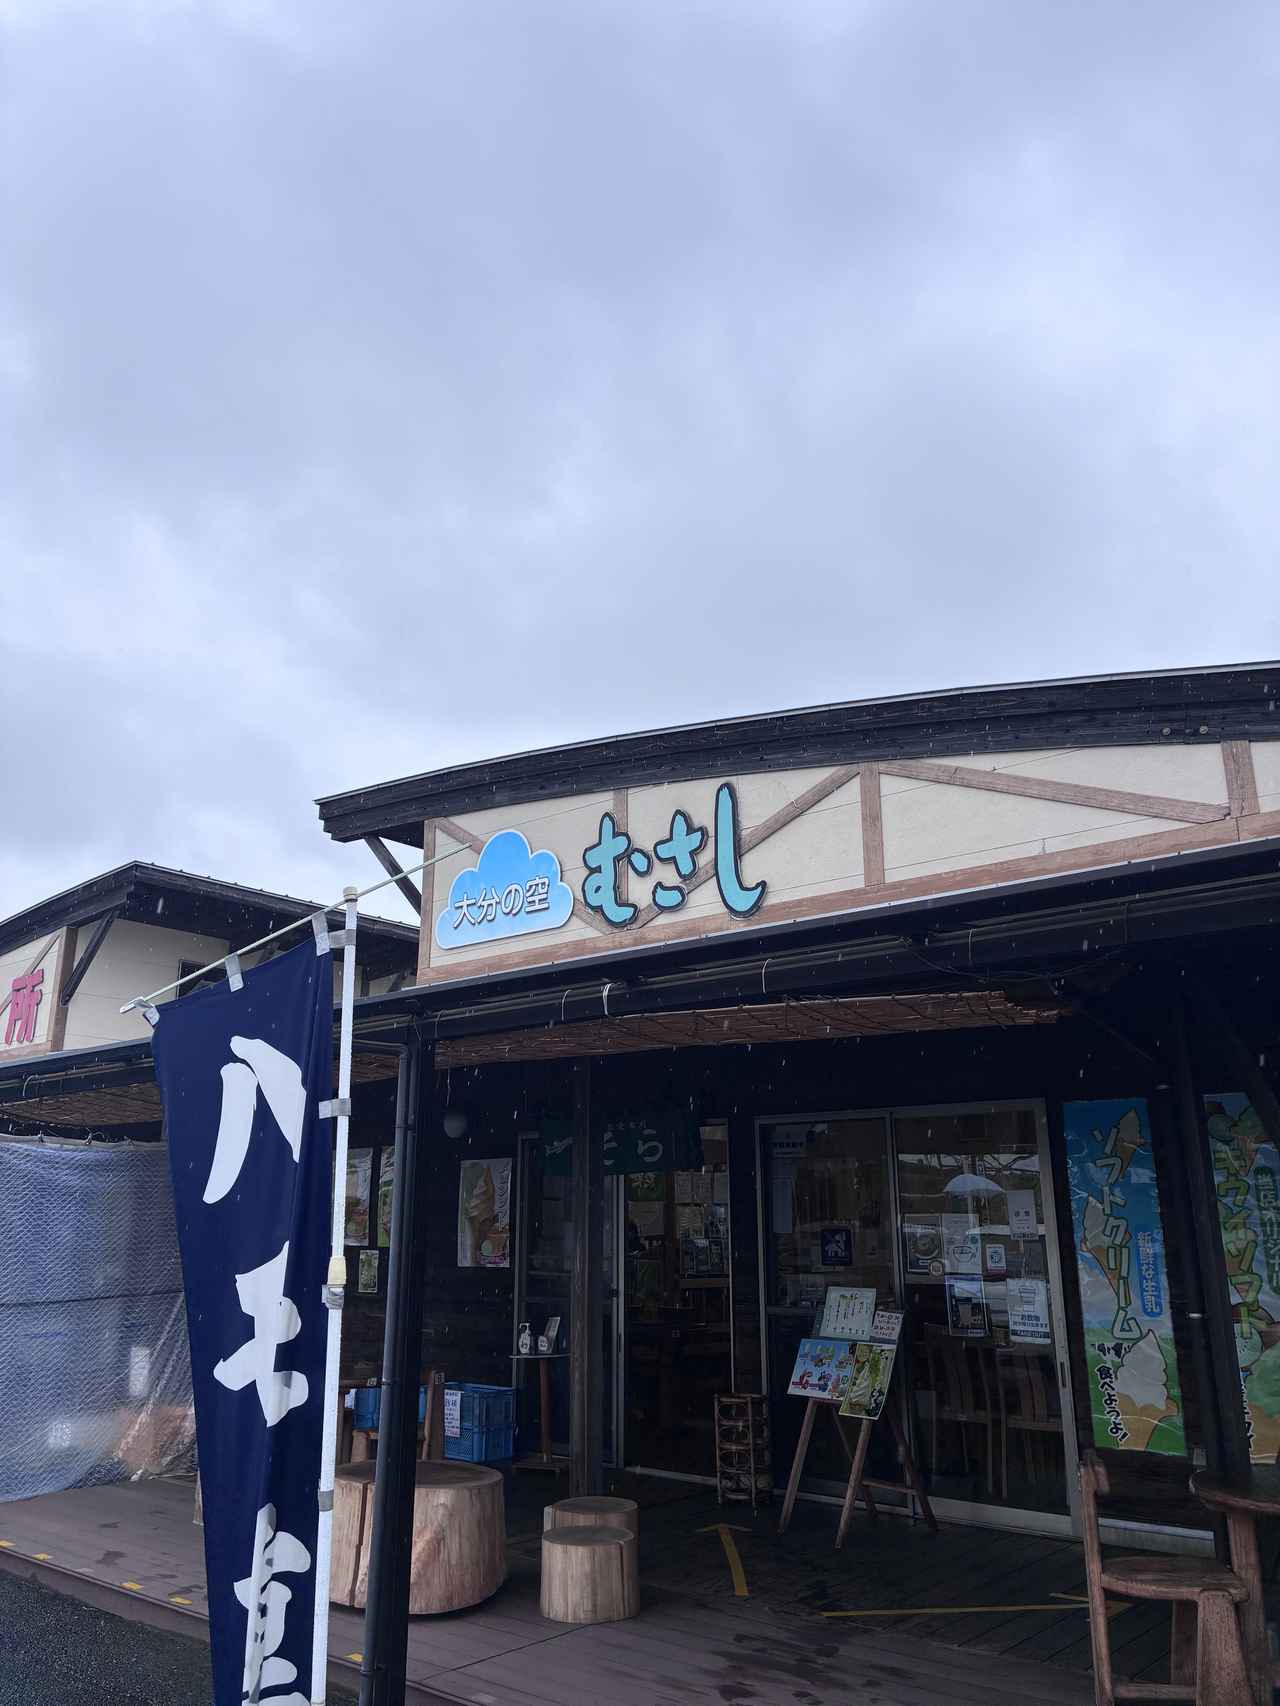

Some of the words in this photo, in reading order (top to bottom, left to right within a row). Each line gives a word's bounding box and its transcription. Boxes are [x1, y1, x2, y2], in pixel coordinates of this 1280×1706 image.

[452, 876, 551, 929] 大分の空
[582, 783, 768, 927] むさし
[1092, 1126, 1142, 1341] ソフトクリーム
